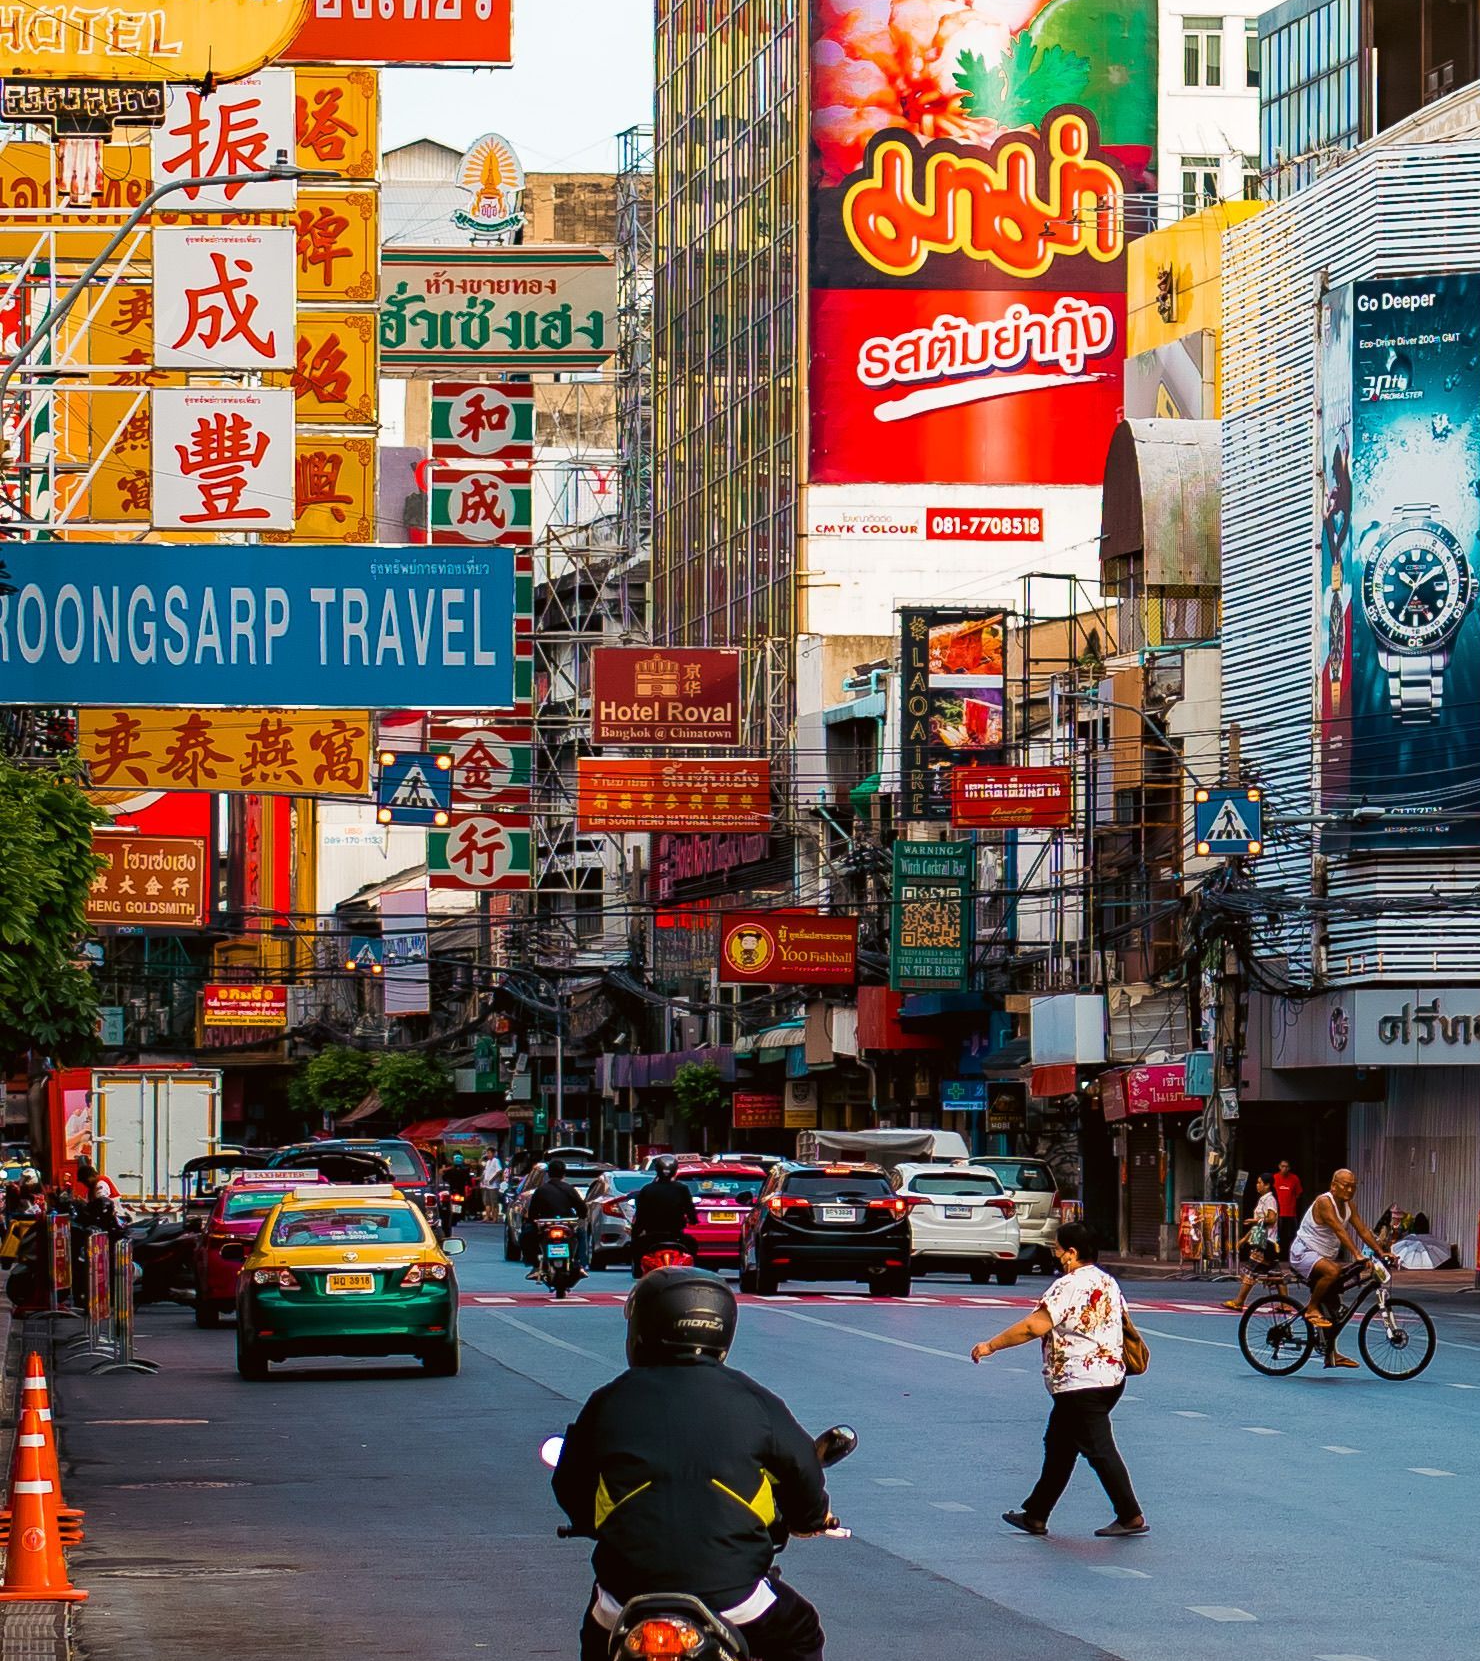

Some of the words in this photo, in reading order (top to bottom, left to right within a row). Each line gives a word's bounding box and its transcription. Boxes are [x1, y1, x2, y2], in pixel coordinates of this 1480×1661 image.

[1357, 295, 1379, 312] Go
[1382, 293, 1436, 311] Deeper
[858, 297, 1114, 388] รสต้มยำกุ้ง
[815, 524, 855, 535] CMYK
[863, 524, 919, 535] COLOUR
[931, 517, 1040, 535] 081-7708518
[310, 585, 497, 666] TRAVEL
[600, 702, 659, 722] Hotel
[668, 702, 731, 724] Royal
[600, 727, 652, 741] Bangkok
[670, 727, 732, 740] Chinatown
[904, 846, 954, 855] WARNING
[125, 900, 196, 916] GOLDSMITH
[810, 951, 852, 963] Fishball
[913, 965, 933, 976] THE
[934, 965, 962, 976] BREW
